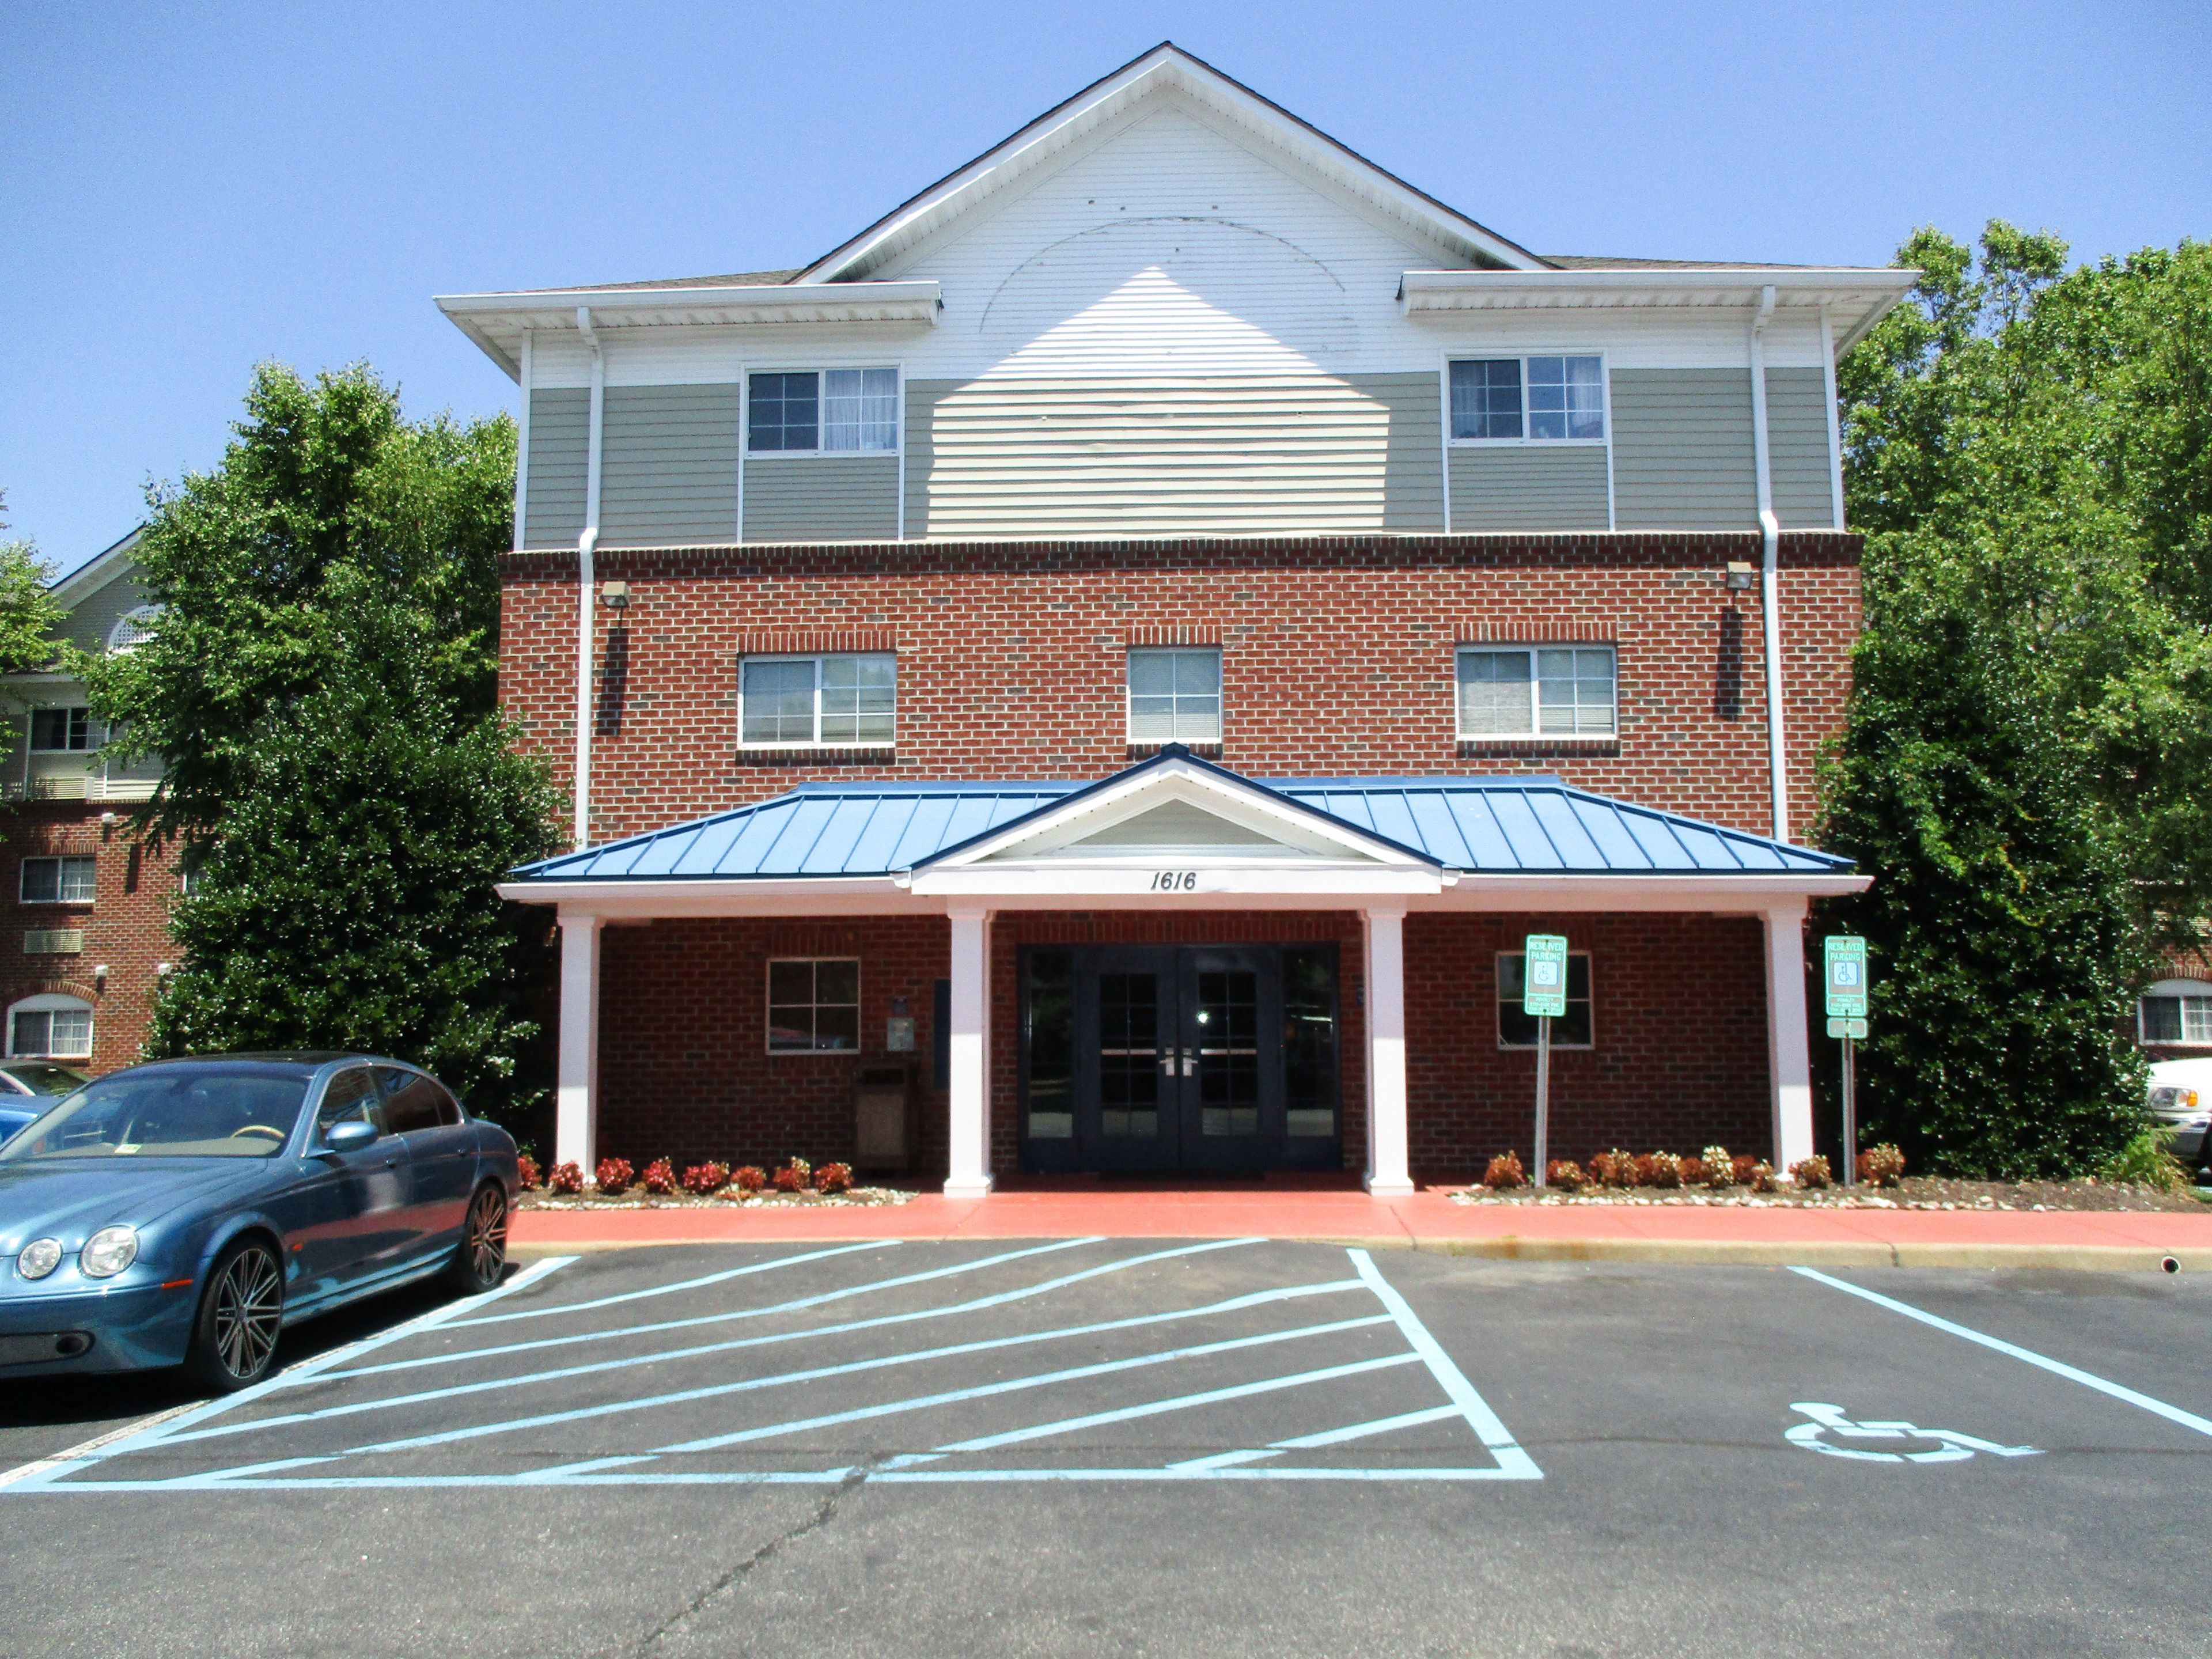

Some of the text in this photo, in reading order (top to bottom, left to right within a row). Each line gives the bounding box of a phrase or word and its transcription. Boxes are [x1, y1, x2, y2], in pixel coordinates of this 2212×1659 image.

[1150, 872, 1196, 891] 1616
[1531, 952, 1562, 961] PARKING
[1830, 953, 1861, 961] PARKING
